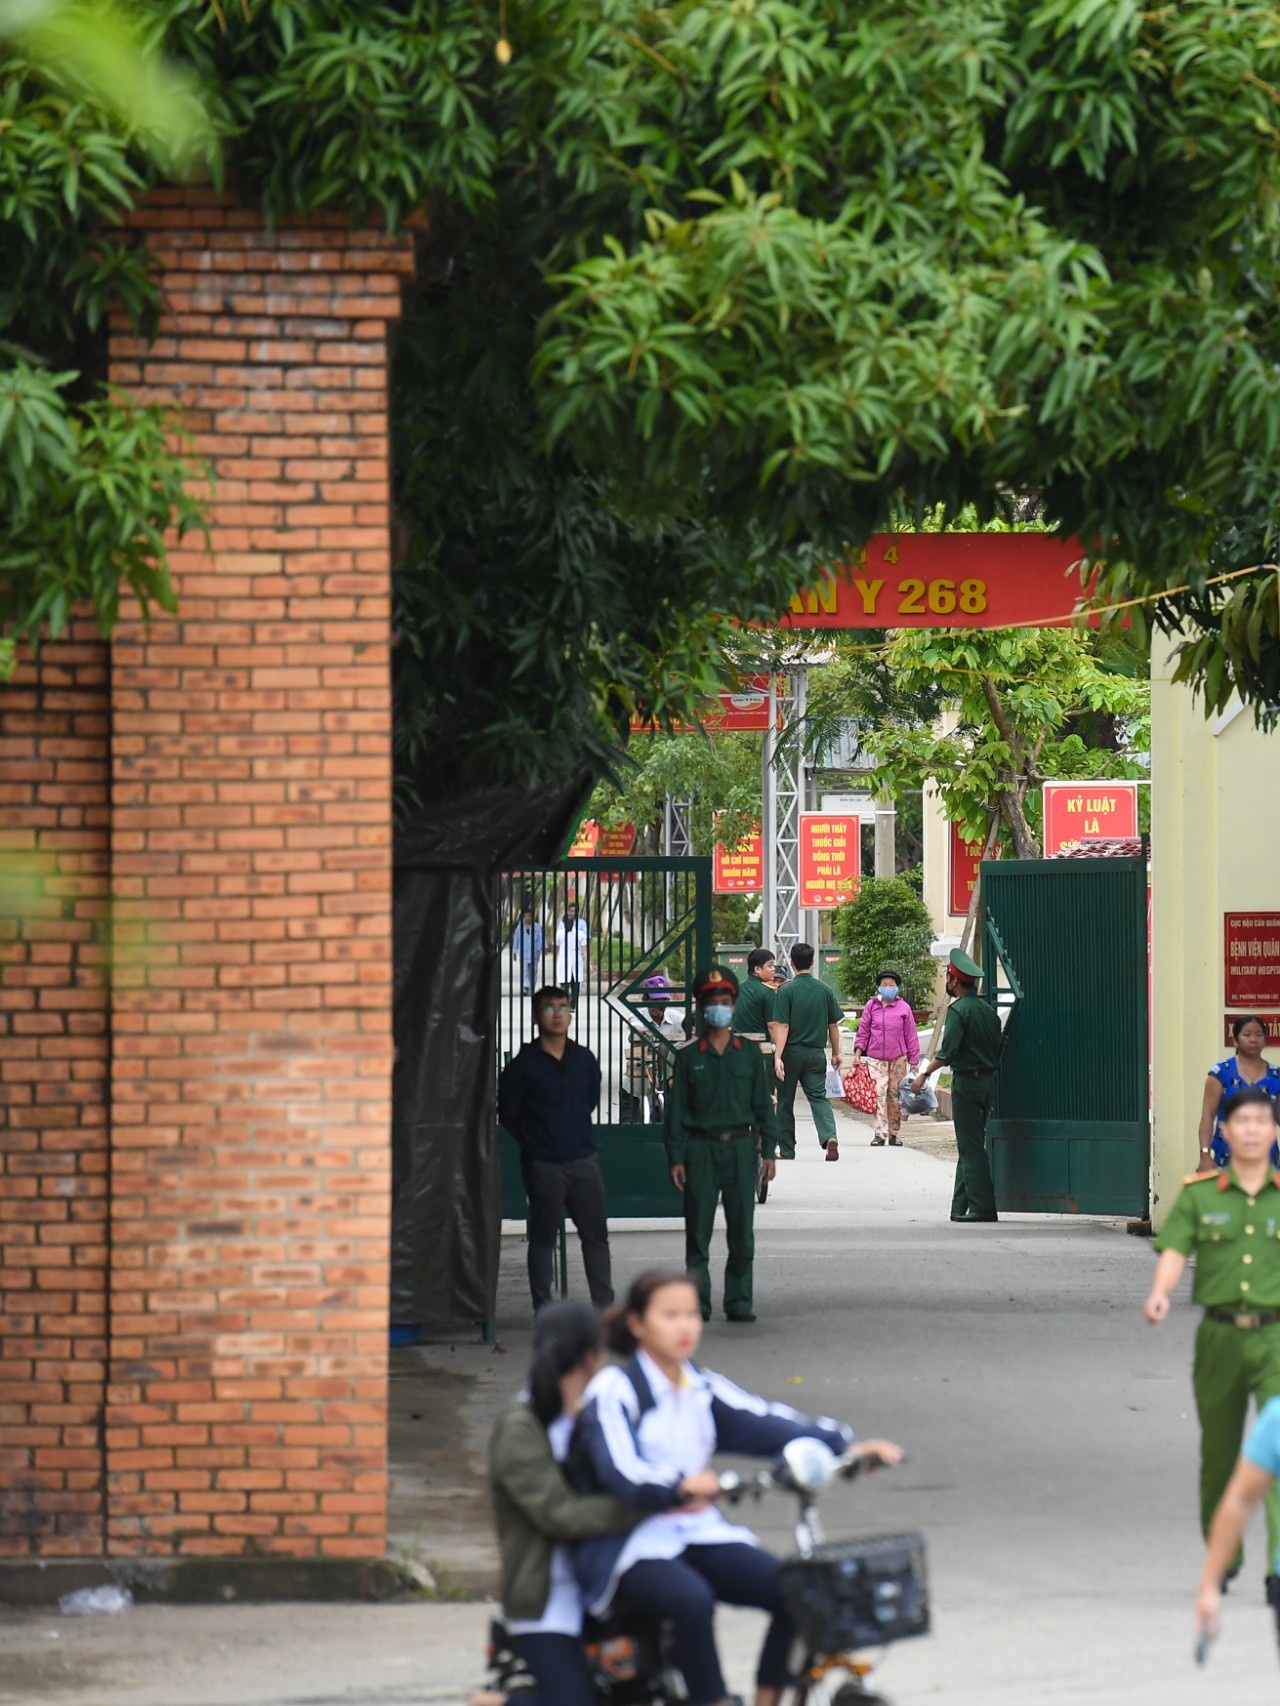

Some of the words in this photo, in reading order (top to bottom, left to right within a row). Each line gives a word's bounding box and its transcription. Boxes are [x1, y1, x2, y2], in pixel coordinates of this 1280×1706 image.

[854, 579, 884, 614] Y
[898, 578, 987, 614] 268
[1086, 796, 1117, 815] LUẬT
[1084, 817, 1100, 834] LÀ
